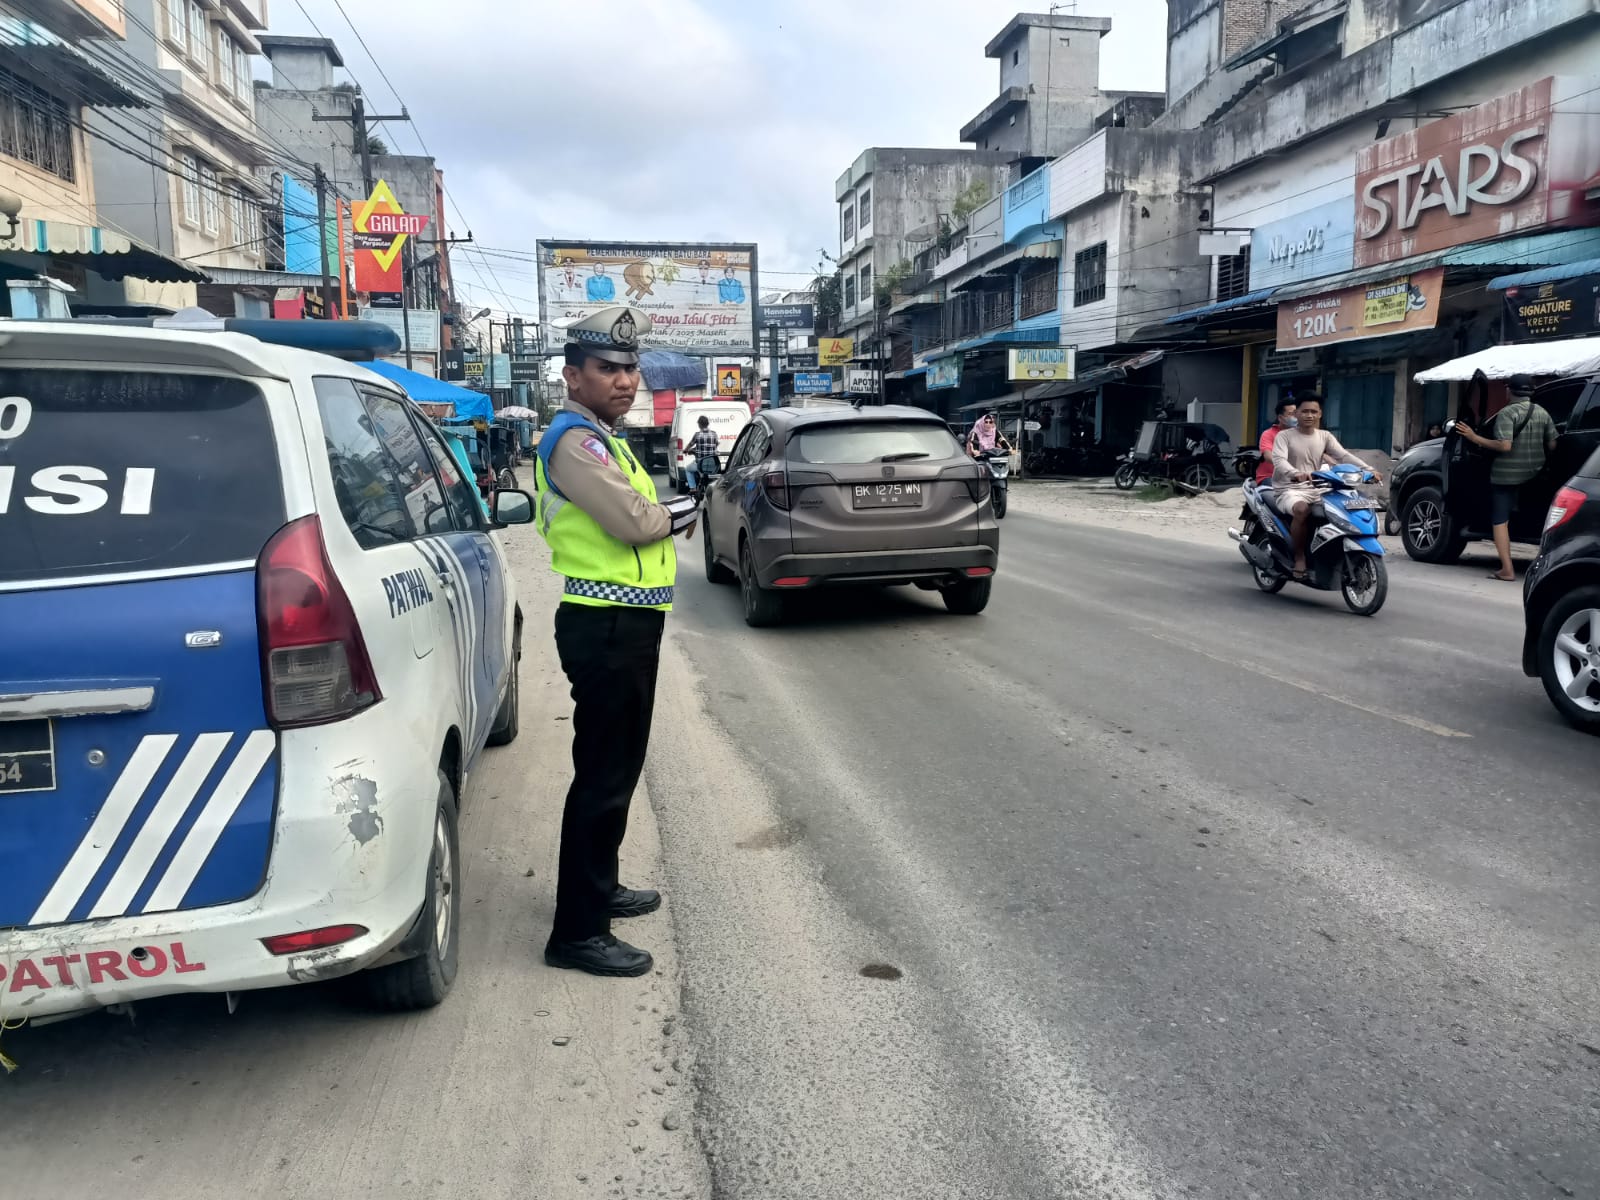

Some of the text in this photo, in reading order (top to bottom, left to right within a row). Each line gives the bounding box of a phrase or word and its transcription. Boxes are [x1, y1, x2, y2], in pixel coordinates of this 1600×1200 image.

[1362, 124, 1544, 240] STARS
[370, 215, 420, 233] GALAN
[674, 249, 692, 259] BATU
[694, 249, 711, 259] BARA
[1267, 227, 1326, 268] Napoli
[1518, 299, 1572, 317] SIGNATURE
[648, 313, 680, 327] Raya
[681, 311, 708, 325] Idul
[709, 312, 737, 327] Fitri
[1293, 312, 1337, 339] 120K
[1526, 315, 1560, 327] KRETEK
[1017, 350, 1066, 363] OPTIK MANDIRI
[855, 483, 921, 497] BK 1275 WN
